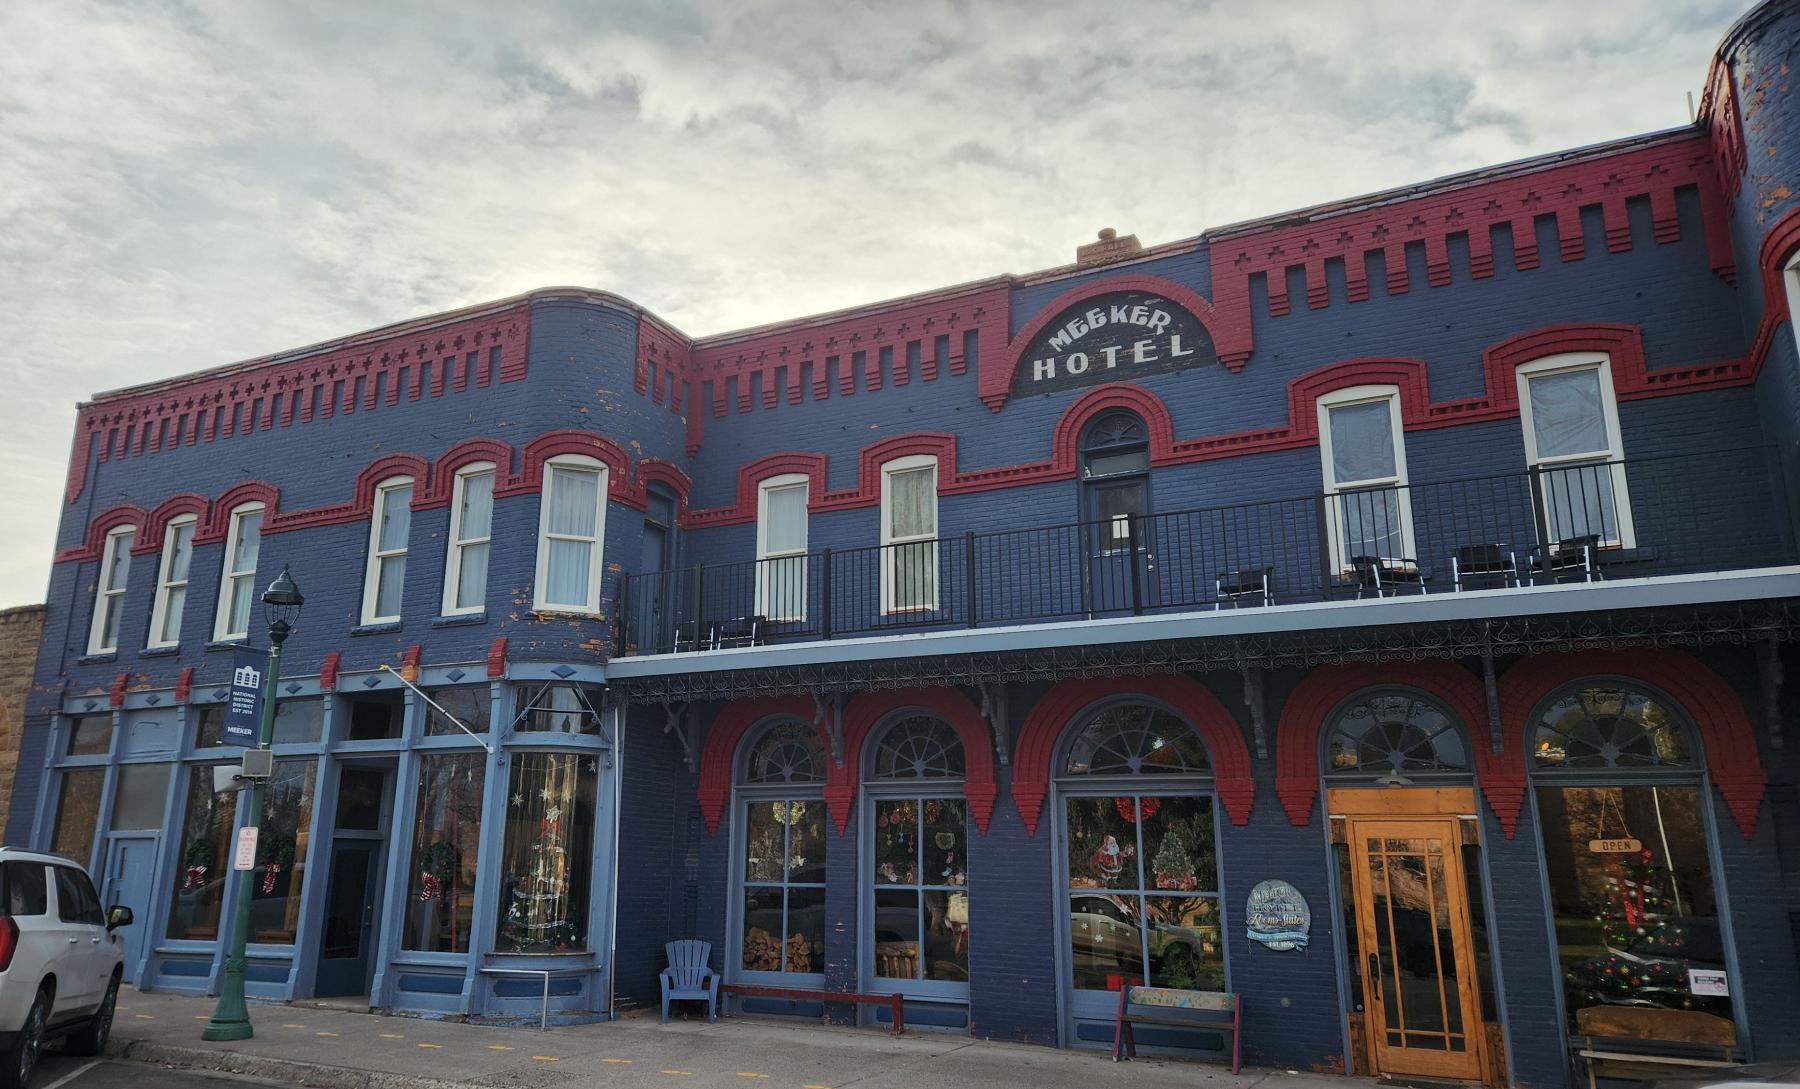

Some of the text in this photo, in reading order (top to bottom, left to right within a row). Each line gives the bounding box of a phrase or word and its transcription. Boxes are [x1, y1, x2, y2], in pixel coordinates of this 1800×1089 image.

[1048, 304, 1172, 353] MEEKER
[1033, 334, 1194, 381] HOTEL
[232, 691, 256, 699] NATIONAL
[227, 726, 252, 735] MEEKER
[1602, 840, 1631, 851] OPEN
